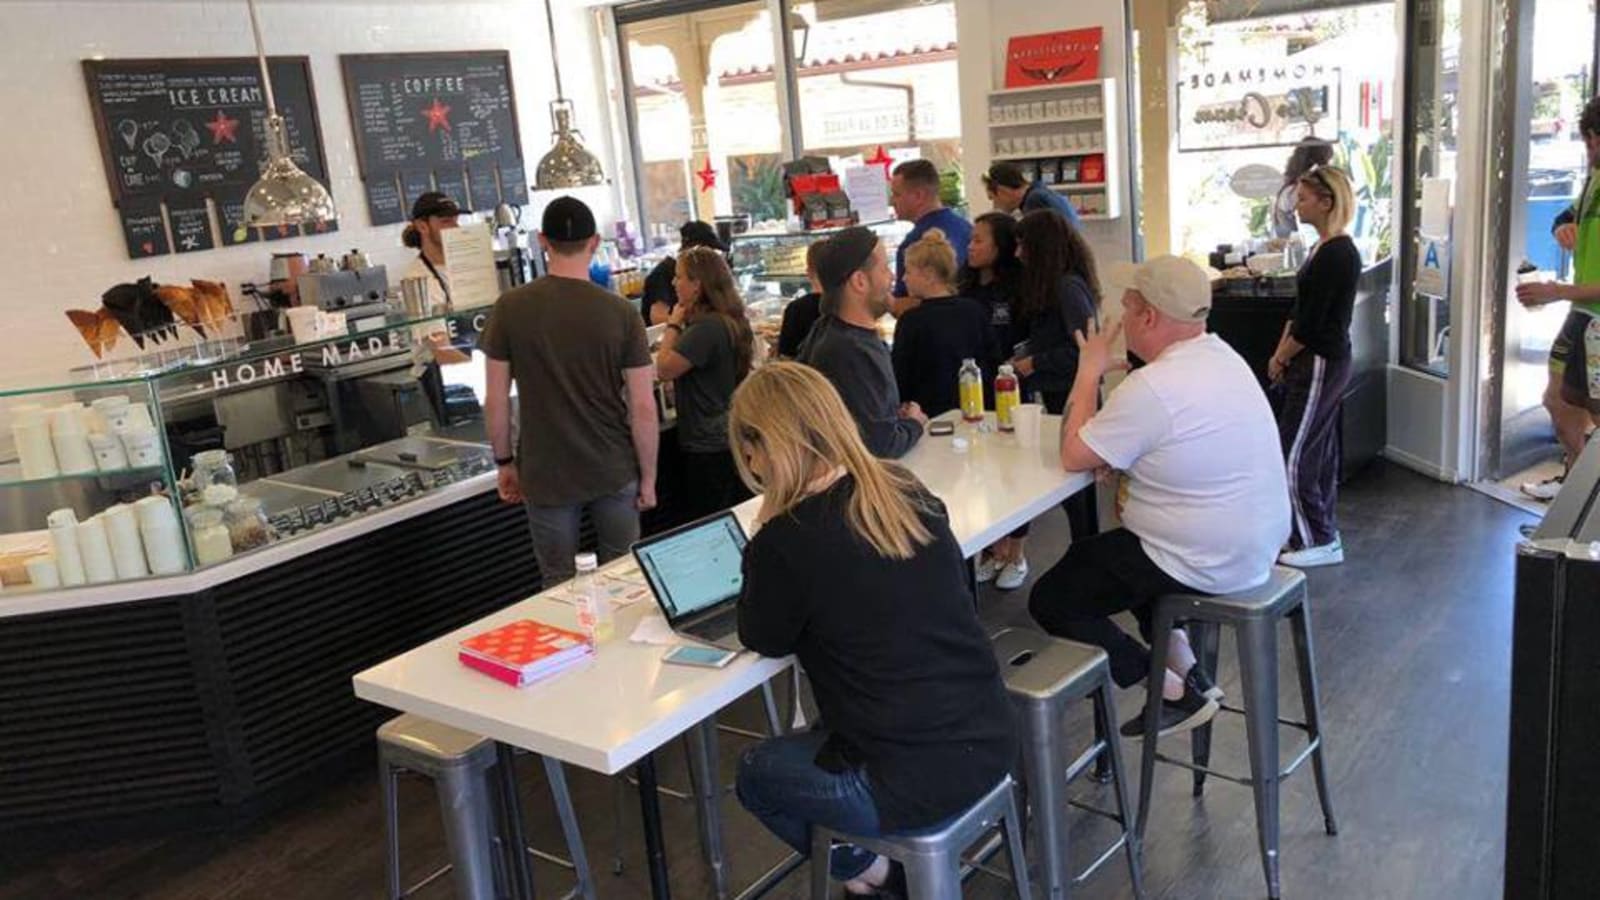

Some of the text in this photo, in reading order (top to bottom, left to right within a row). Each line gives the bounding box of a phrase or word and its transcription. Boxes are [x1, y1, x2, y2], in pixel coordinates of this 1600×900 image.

[169, 87, 263, 106] ICE CREAM
[403, 77, 465, 94] COFFEE
[1424, 243, 1440, 269] A
[212, 353, 303, 390] HOME
[321, 331, 400, 368] MADE
